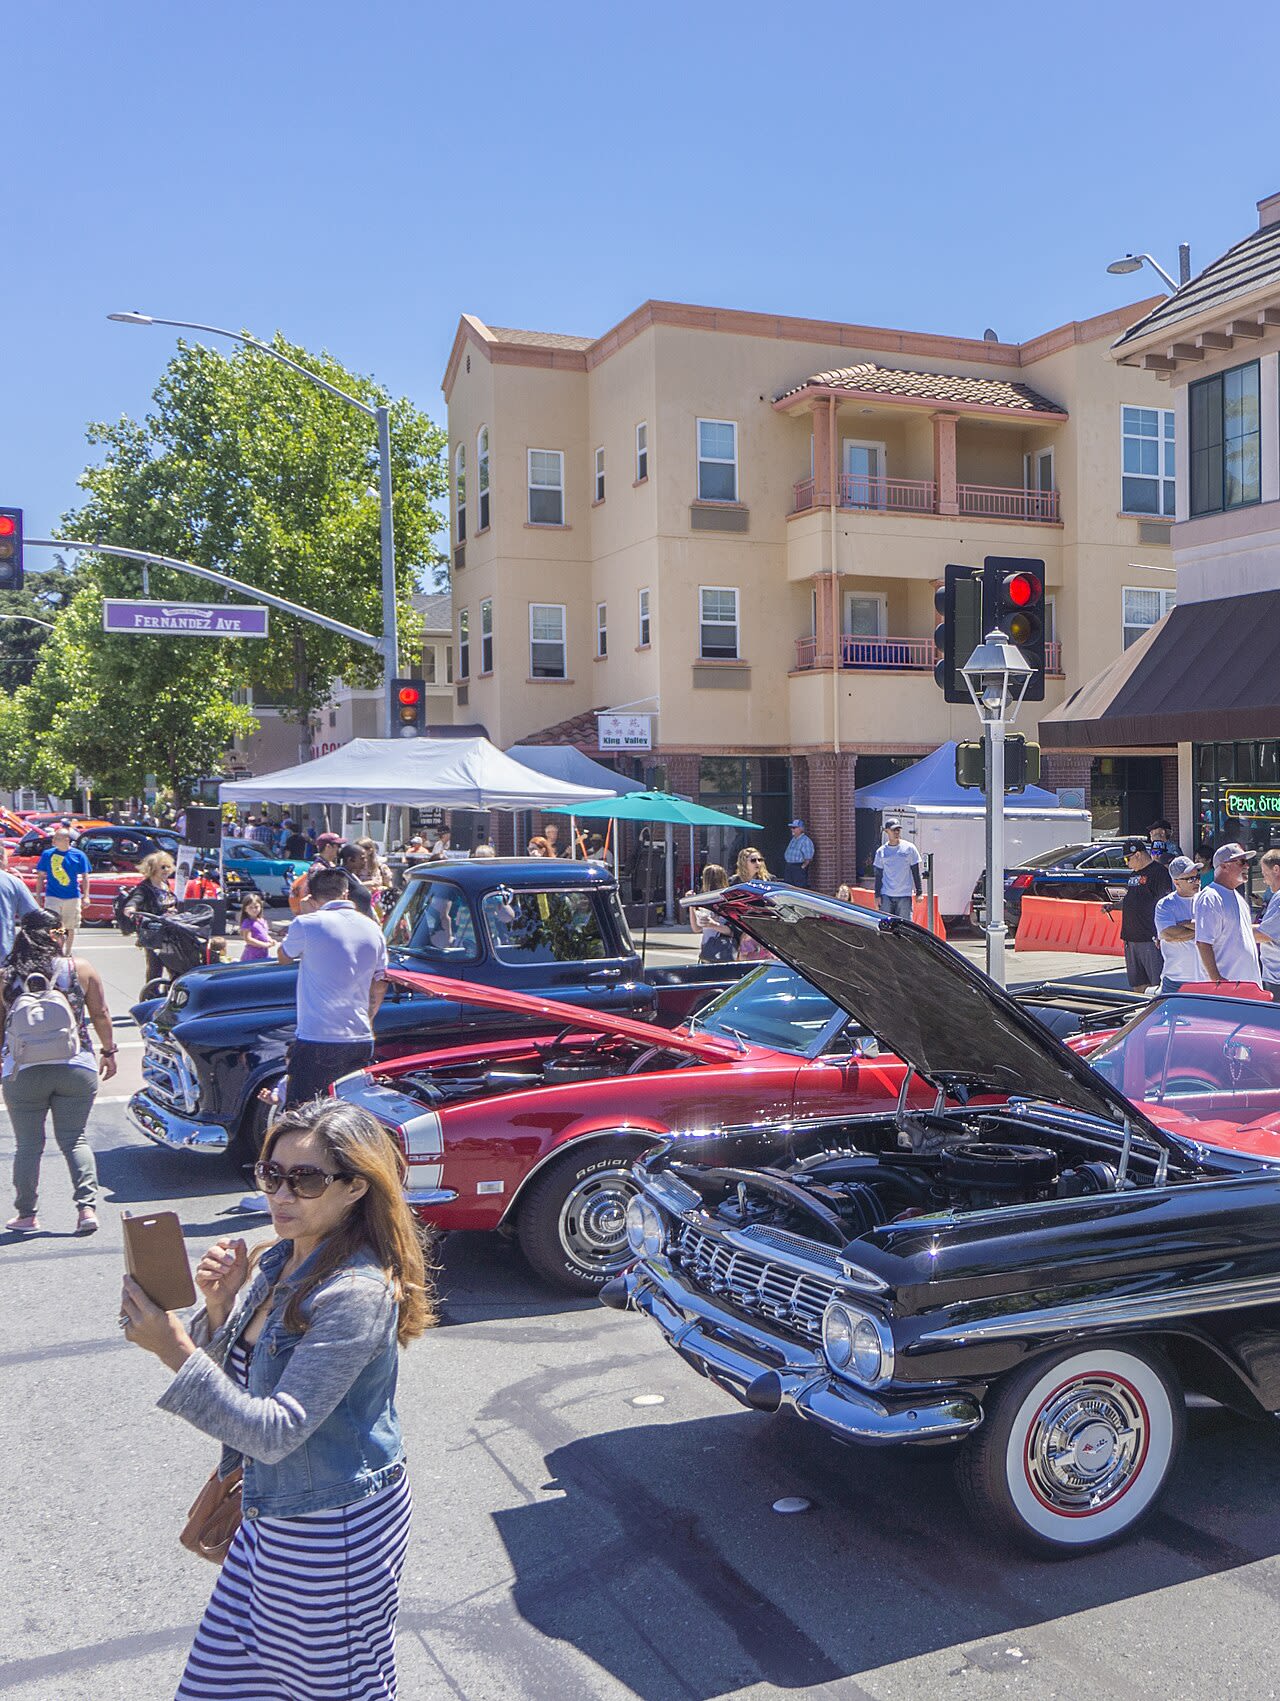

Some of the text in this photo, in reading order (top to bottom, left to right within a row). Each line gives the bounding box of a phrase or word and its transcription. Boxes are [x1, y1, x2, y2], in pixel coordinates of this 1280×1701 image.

[134, 614, 241, 631] FERNANDEZ AVE
[603, 737, 648, 745] King Valley
[1229, 795, 1256, 812] PEAR
[575, 1159, 628, 1180] Radial
[564, 1261, 615, 1283] odrich
